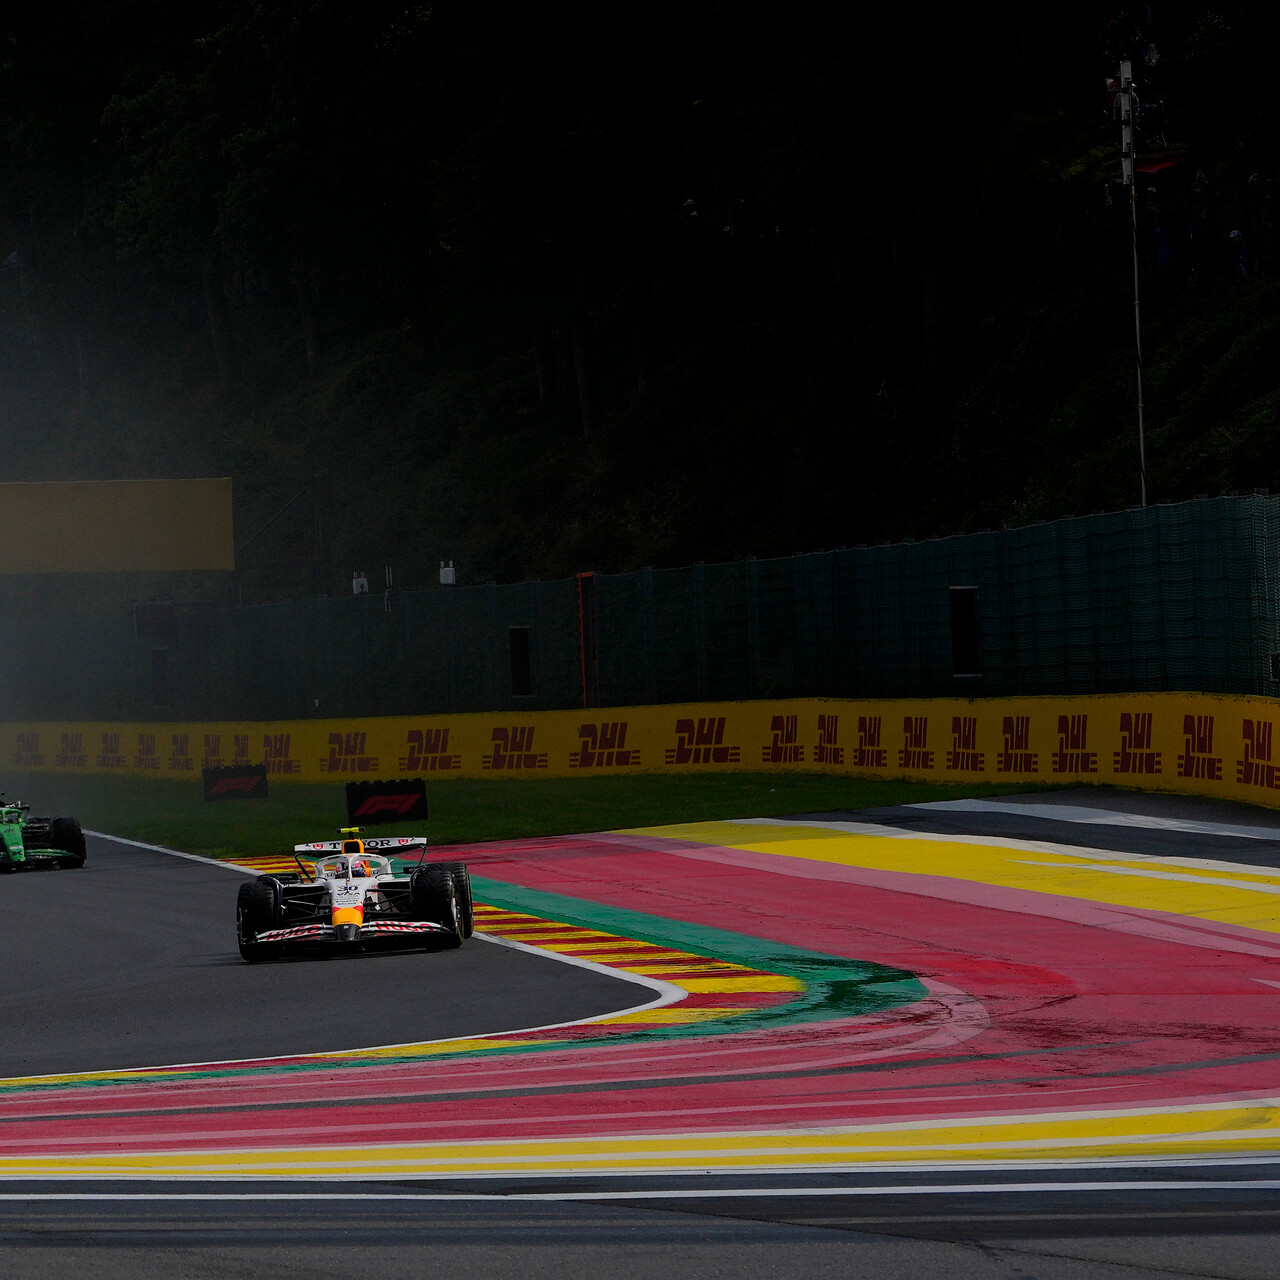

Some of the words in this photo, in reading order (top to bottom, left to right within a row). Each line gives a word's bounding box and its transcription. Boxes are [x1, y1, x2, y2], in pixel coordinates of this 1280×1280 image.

[328, 731, 370, 772] DHL
[406, 728, 453, 771] DHL
[491, 726, 540, 769] DHL
[578, 722, 631, 767] DHL
[675, 717, 731, 764] DHL
[769, 714, 800, 763] DHL
[818, 714, 839, 764] DHL
[858, 716, 882, 767] DHL
[903, 716, 929, 769] DHL
[951, 717, 979, 771] DHL
[1003, 716, 1032, 772] DHL
[1057, 714, 1090, 773] DHL
[1119, 712, 1156, 774] DHL
[1183, 714, 1217, 780] DHL
[1242, 718, 1278, 788] DHL
[329, 839, 391, 849] TOR
